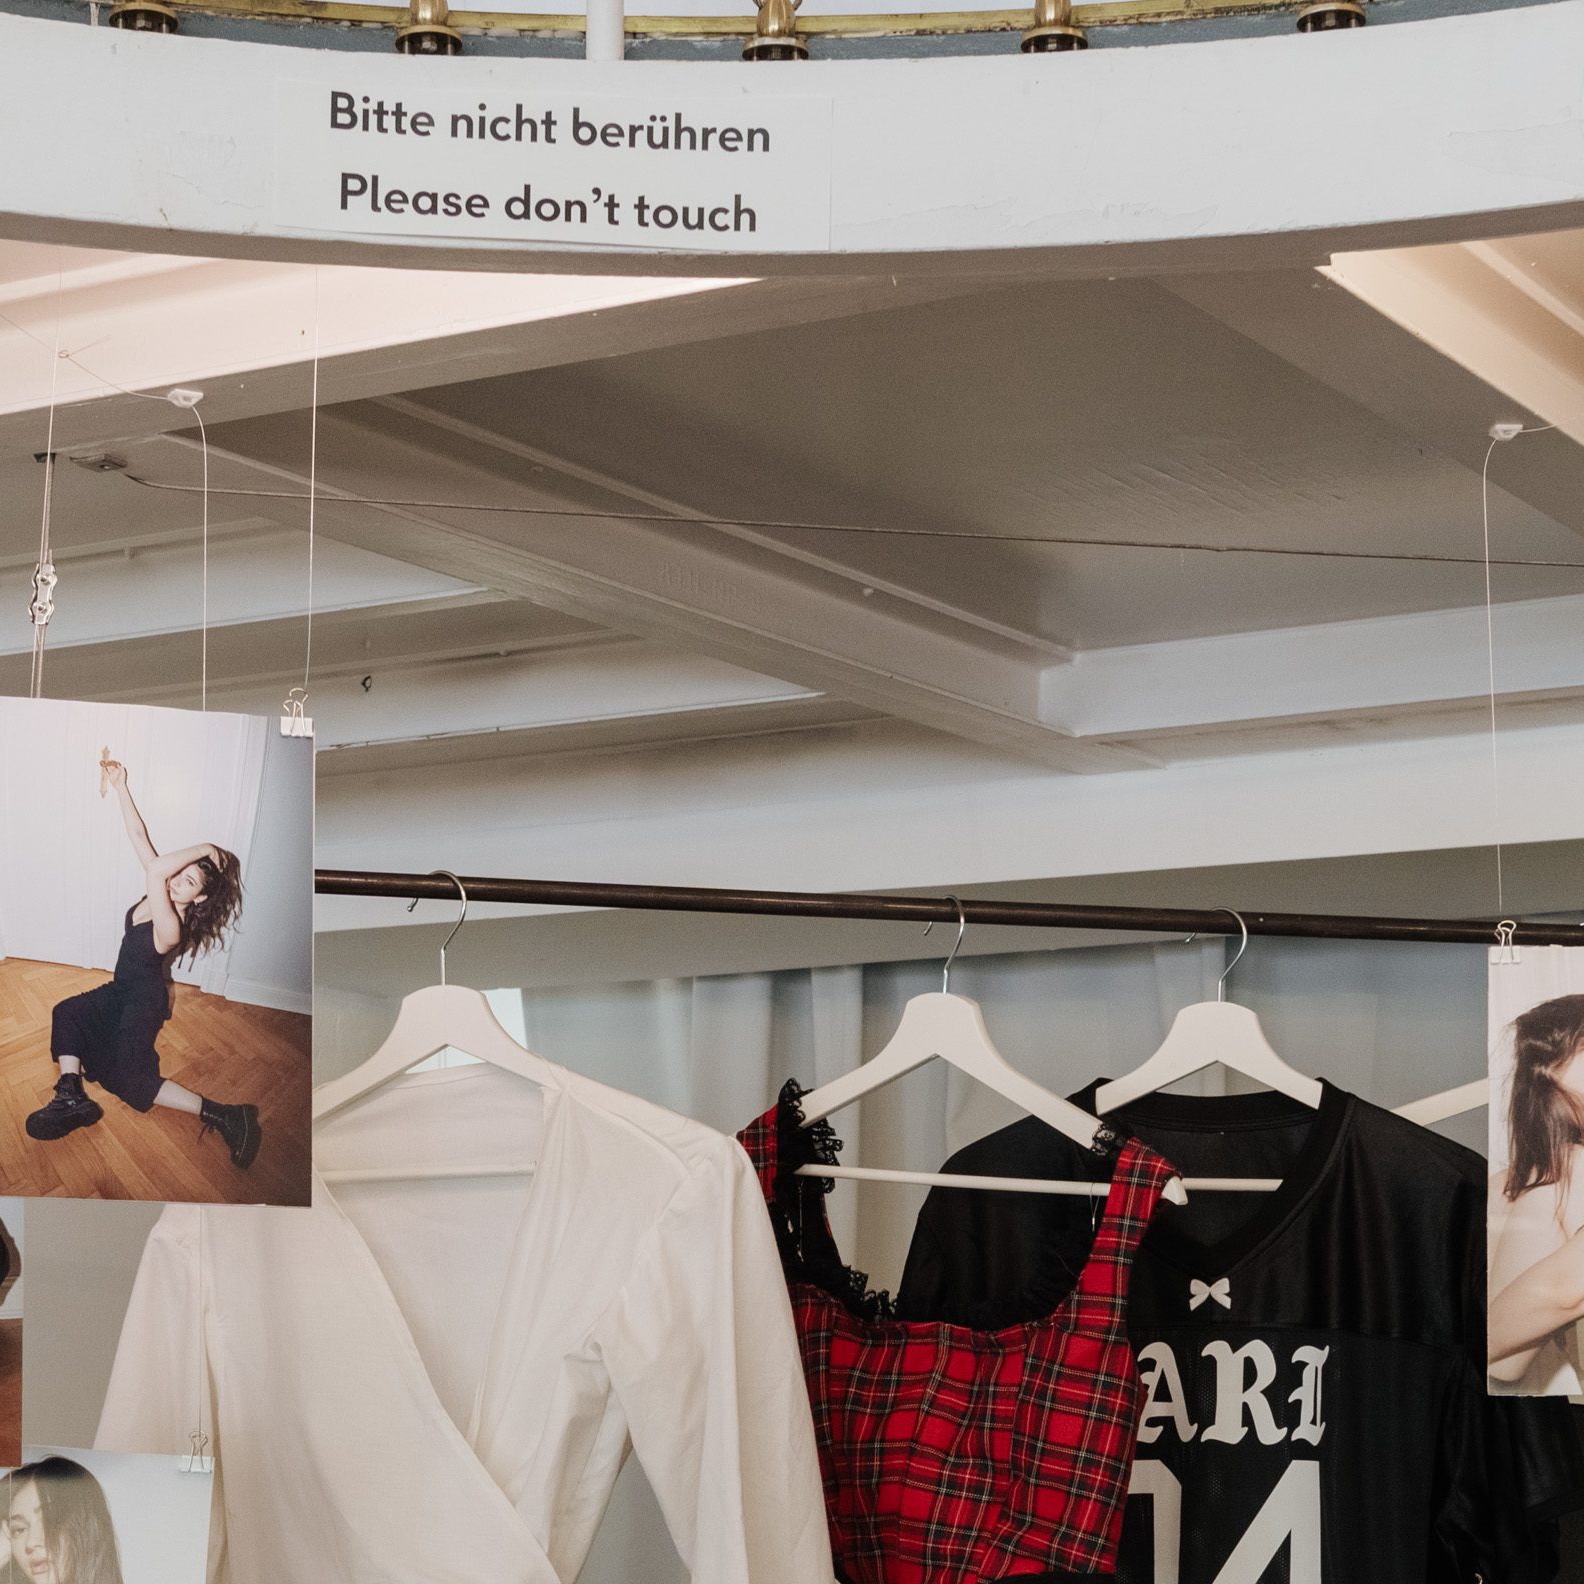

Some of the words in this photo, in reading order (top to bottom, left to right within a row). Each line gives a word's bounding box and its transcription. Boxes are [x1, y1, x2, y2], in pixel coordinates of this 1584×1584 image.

[329, 90, 435, 137] Bitte
[449, 102, 557, 145] nicht
[572, 107, 771, 153] berühren
[339, 172, 490, 218] Please
[504, 184, 620, 227] don't
[633, 194, 757, 232] touch
